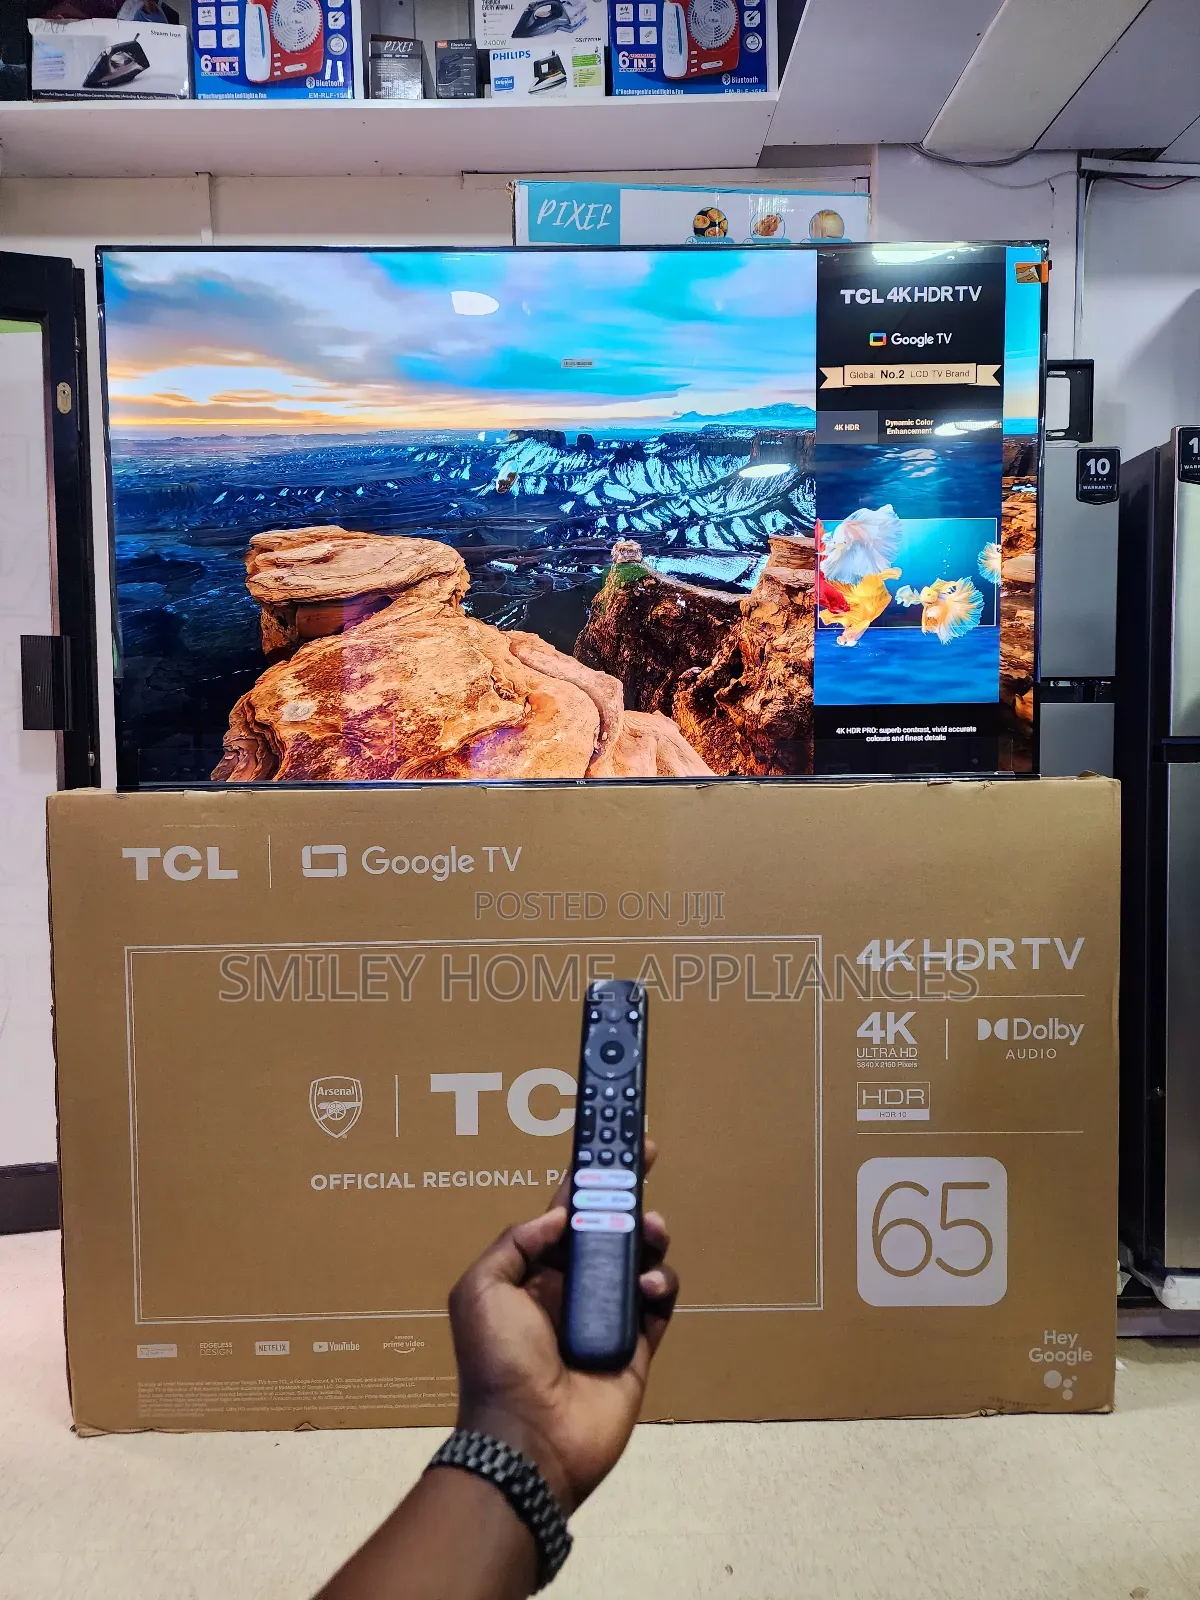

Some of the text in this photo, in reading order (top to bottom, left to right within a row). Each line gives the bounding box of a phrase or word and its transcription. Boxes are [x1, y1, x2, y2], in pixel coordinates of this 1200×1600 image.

[384, 41, 414, 52] PIXEL
[492, 50, 531, 61] PHILIPS
[619, 51, 630, 68] 6
[634, 59, 647, 68] IN
[650, 58, 657, 68] 1
[216, 62, 229, 72] IN
[233, 62, 239, 72] 1
[732, 76, 759, 84] Bluetooth
[536, 199, 612, 231] PIXEL
[840, 289, 884, 304] TCL
[886, 287, 912, 303] 4K
[953, 285, 982, 302] TV
[891, 332, 953, 348] Google TV
[850, 369, 970, 380] Global No.2 LCD TV Brand
[885, 419, 914, 428] Dynamic
[916, 418, 934, 426] Color
[1189, 437, 1200, 454] 1
[1086, 458, 1110, 475] 10
[902, 726, 931, 734] contrast,
[122, 845, 238, 881] TCL
[361, 845, 522, 882] Google TV
[856, 937, 1086, 972] 4K HDR TV
[856, 1011, 918, 1044] 4K
[1014, 1018, 1084, 1046] Dolby
[856, 1048, 918, 1058] ULTRA HD
[1006, 1048, 1057, 1060] AUDIO
[317, 1086, 355, 1096] Arsenal
[862, 1088, 924, 1105] HDR
[430, 1068, 579, 1136] TC
[310, 1172, 415, 1190] OFFICIAL
[422, 1169, 539, 1188] REGIONAL
[872, 1180, 993, 1278] 65
[329, 1341, 360, 1352] YouTube
[383, 1341, 404, 1349] prime
[1044, 1328, 1078, 1348] Hey
[258, 1344, 286, 1352] NETFLIX
[1028, 1347, 1093, 1366] Google
